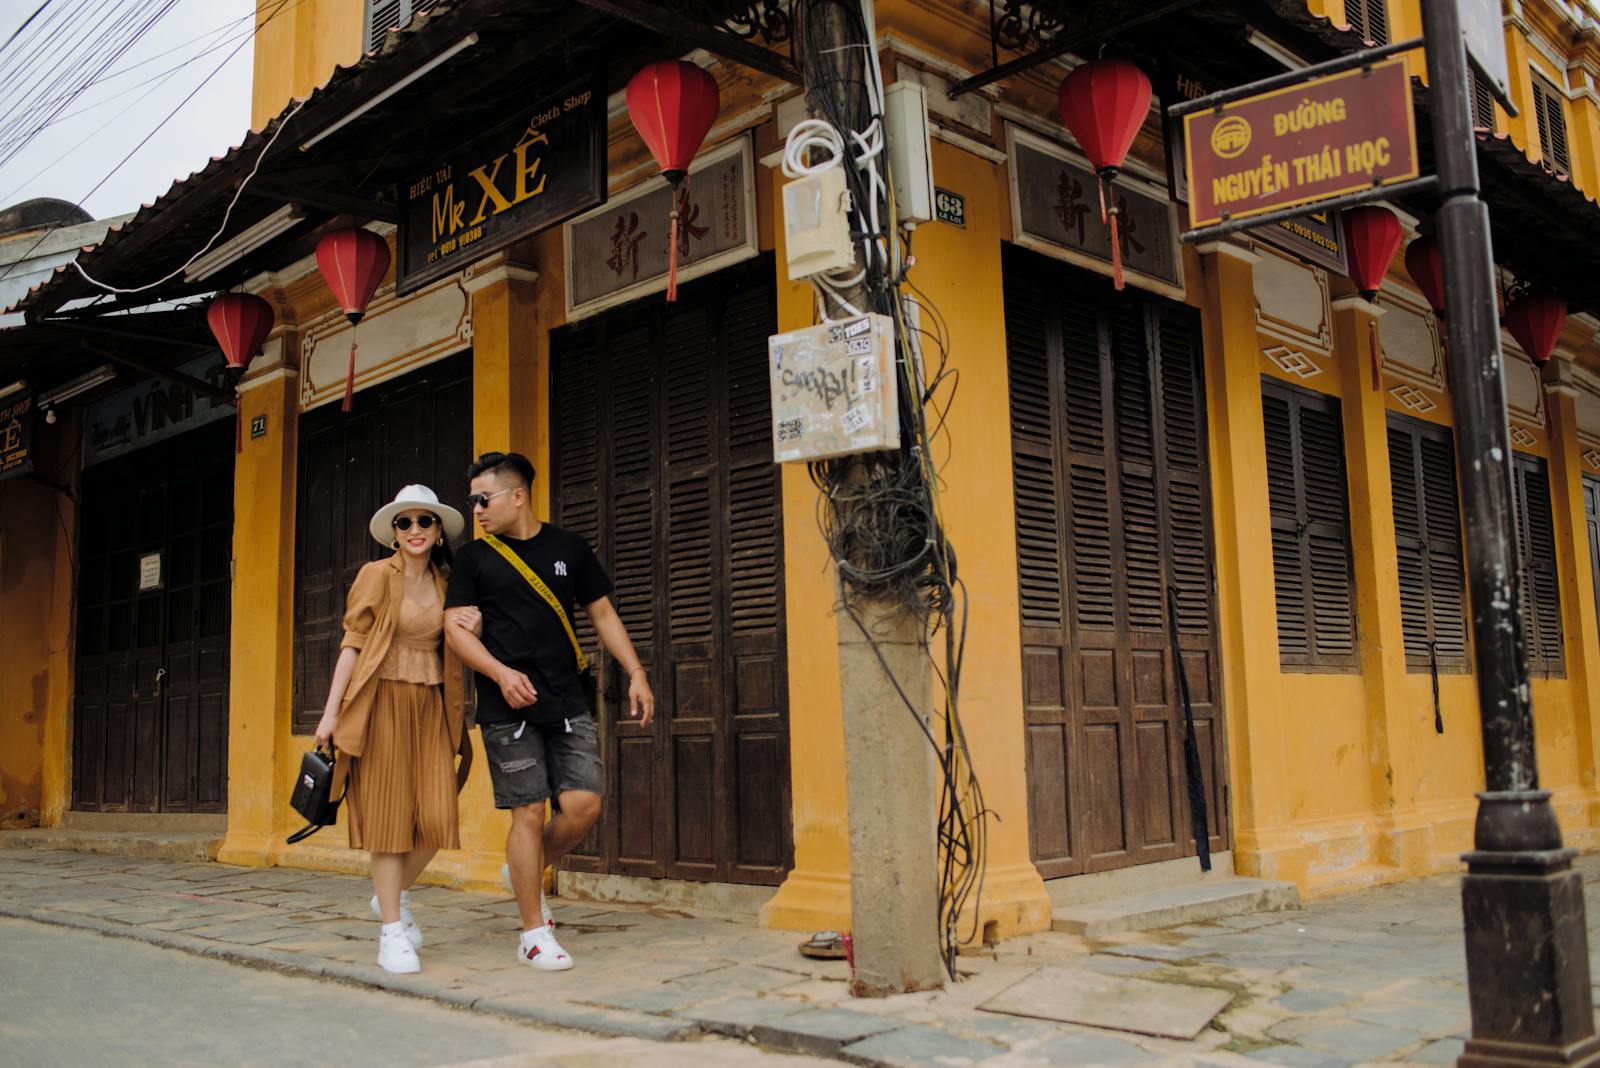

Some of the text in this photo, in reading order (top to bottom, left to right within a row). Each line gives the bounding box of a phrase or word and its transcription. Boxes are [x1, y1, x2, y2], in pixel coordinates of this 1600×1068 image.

[531, 90, 592, 129] Cloth Shop
[1273, 97, 1346, 137] ĐƯỜNG
[468, 127, 549, 227] XÊ
[1213, 136, 1390, 205] NGUYỄN THÁI HỌC
[937, 193, 963, 217] 63
[253, 418, 264, 432] 71
